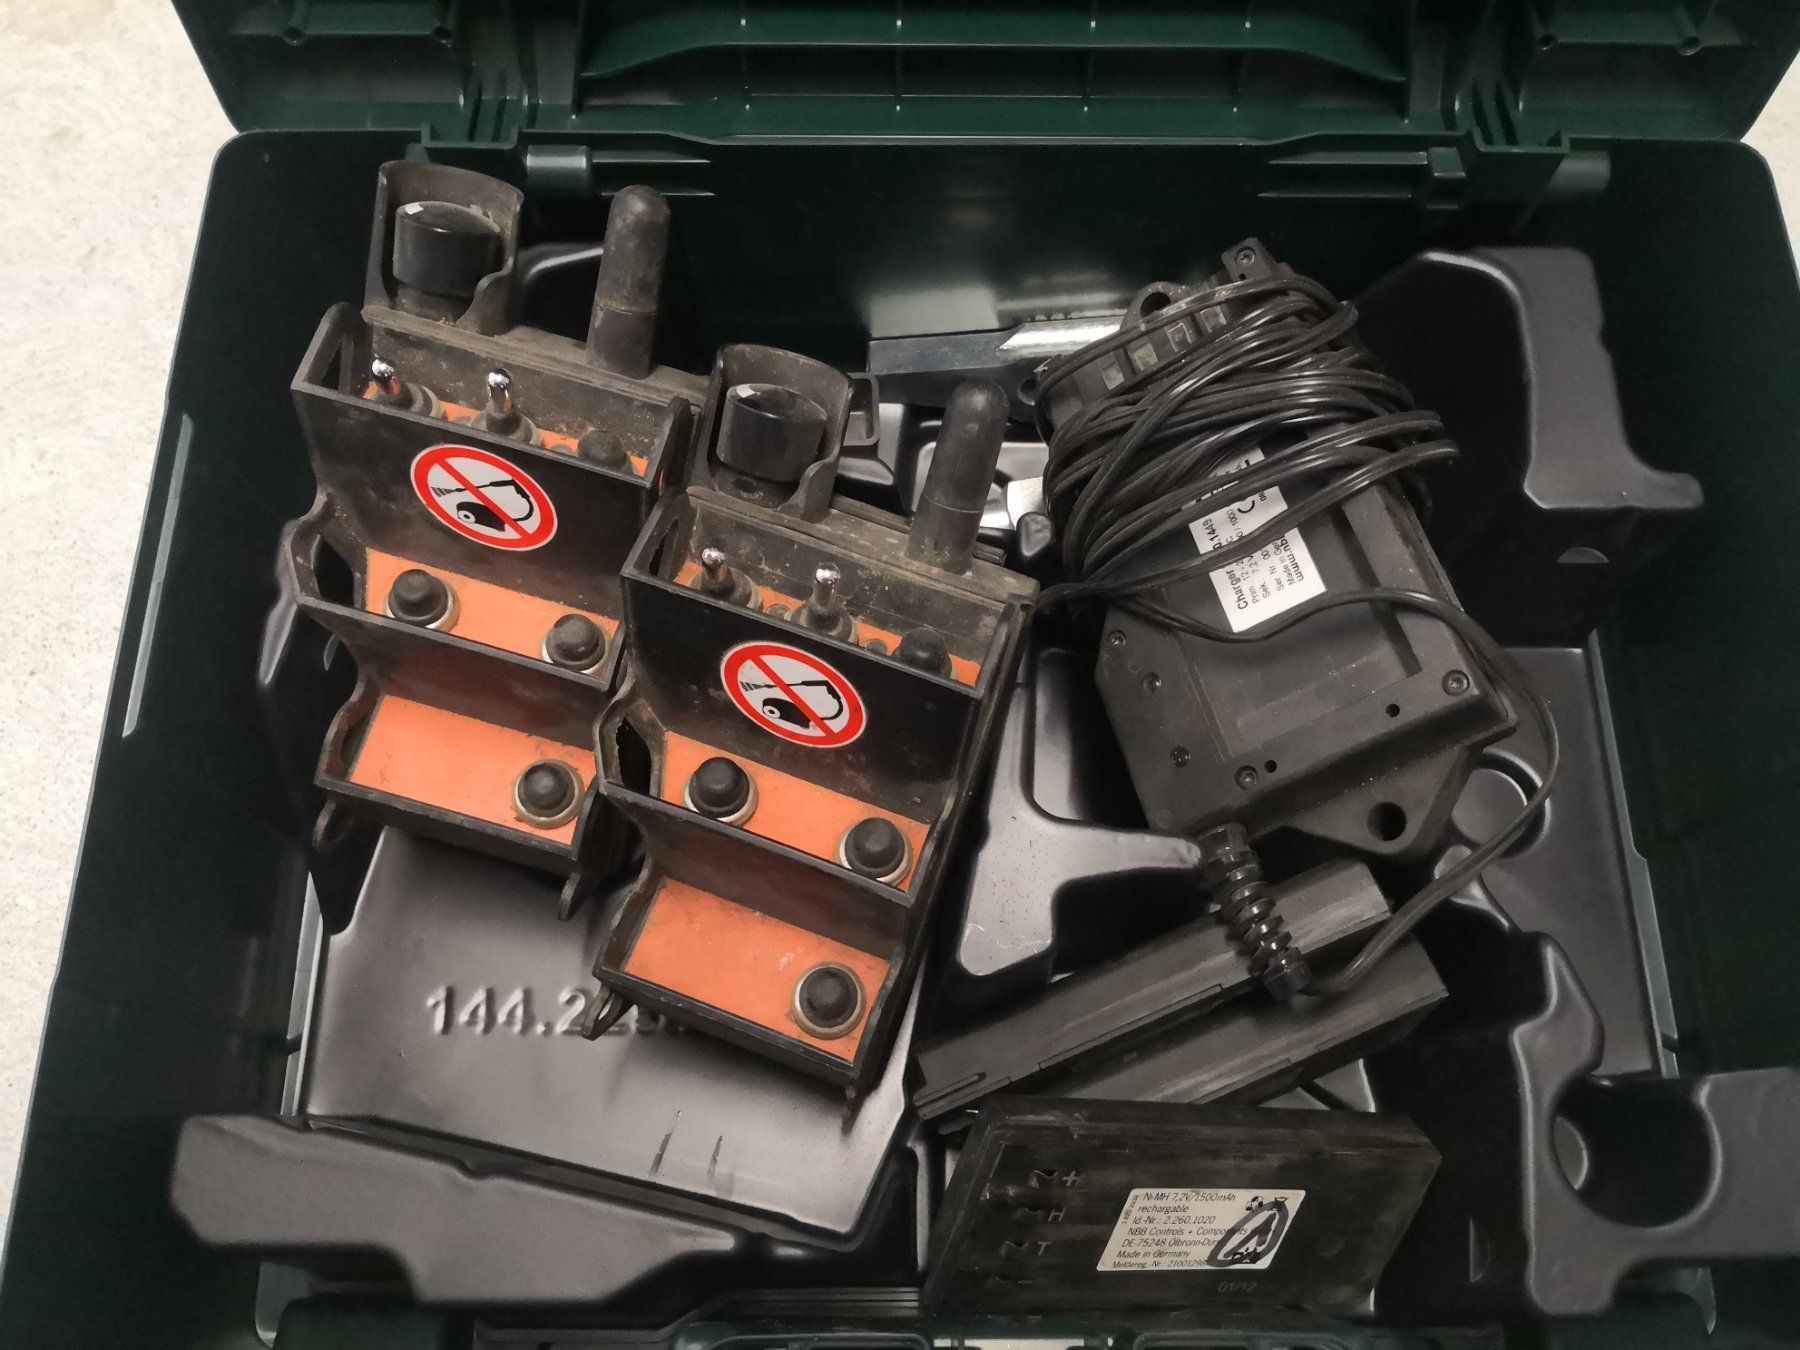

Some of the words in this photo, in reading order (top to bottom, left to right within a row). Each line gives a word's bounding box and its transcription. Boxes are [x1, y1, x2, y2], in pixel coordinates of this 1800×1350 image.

[1202, 517, 1223, 551] 0.1449
[1278, 533, 1304, 583] www.nb
[1281, 563, 1297, 586] Made
[1224, 568, 1250, 610] Charger
[1143, 1192, 1170, 1201] Ni-MH
[1137, 1203, 1189, 1214] rechargable
[1162, 1215, 1216, 1225] 2.260.1020
[1149, 1226, 1184, 1236] Controls
[1121, 1238, 1167, 1248] DE-75248
[1116, 1250, 1141, 1259] Made
[1142, 1250, 1151, 1258] in
[1152, 1249, 1191, 1259] Germany
